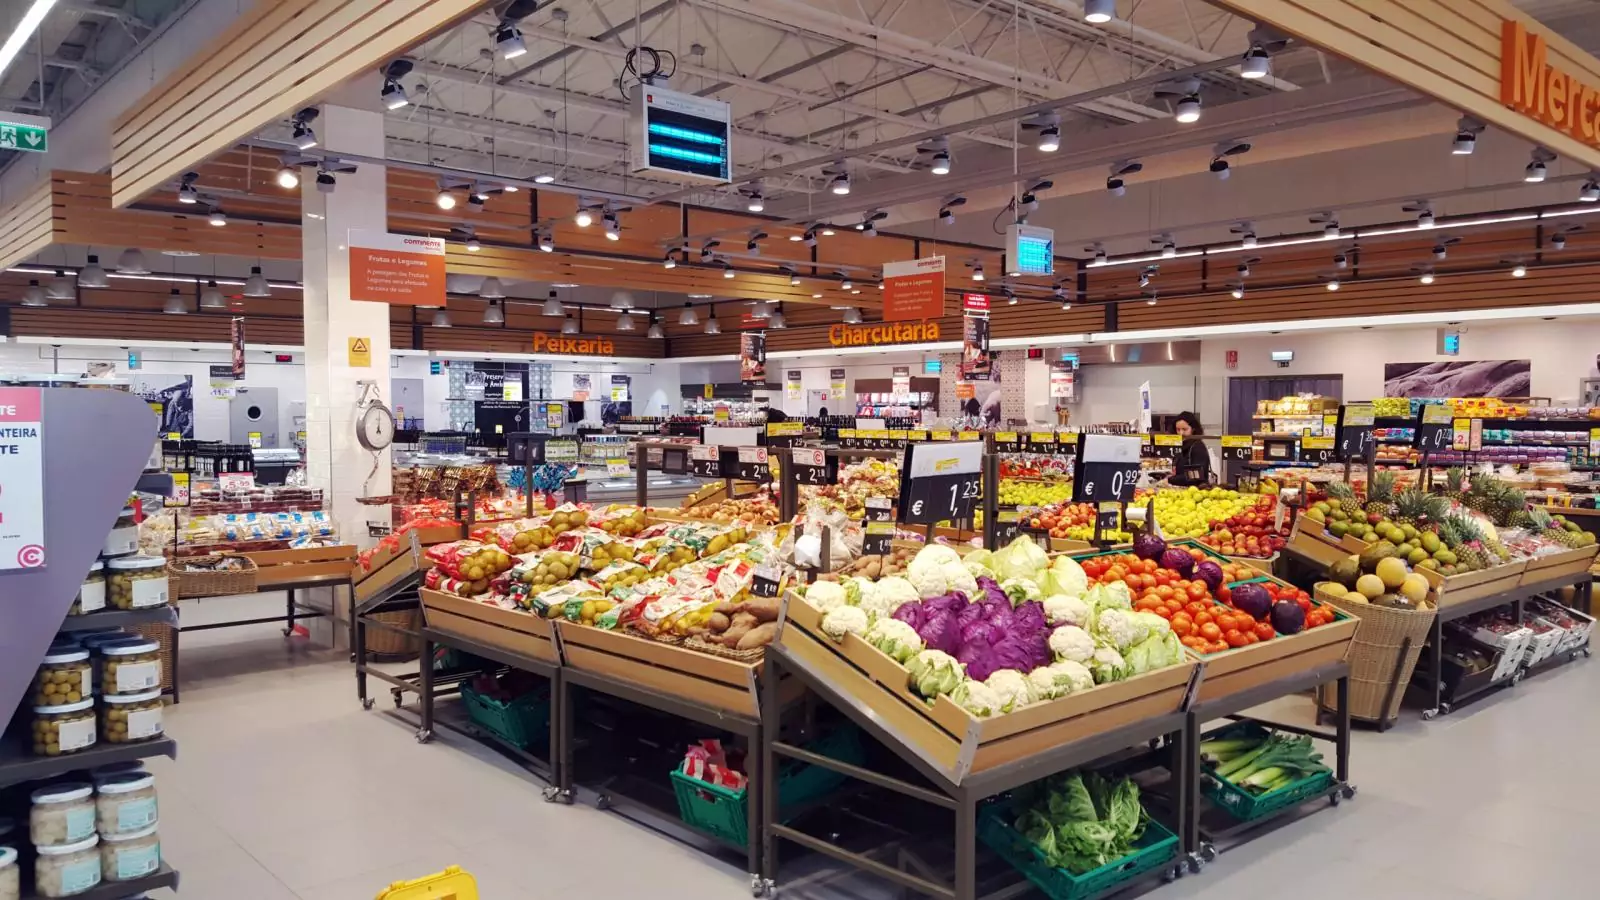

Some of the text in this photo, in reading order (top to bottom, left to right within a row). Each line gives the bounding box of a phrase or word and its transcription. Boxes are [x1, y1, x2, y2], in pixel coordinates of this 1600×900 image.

[368, 255, 390, 263] Frutas
[398, 257, 428, 267] Legumes
[533, 332, 614, 354] Peixaria
[829, 319, 939, 346] Charcutaria
[0, 445, 19, 454] TE
[1085, 470, 1138, 500] € 0,99
[911, 480, 979, 517] € 1,25
